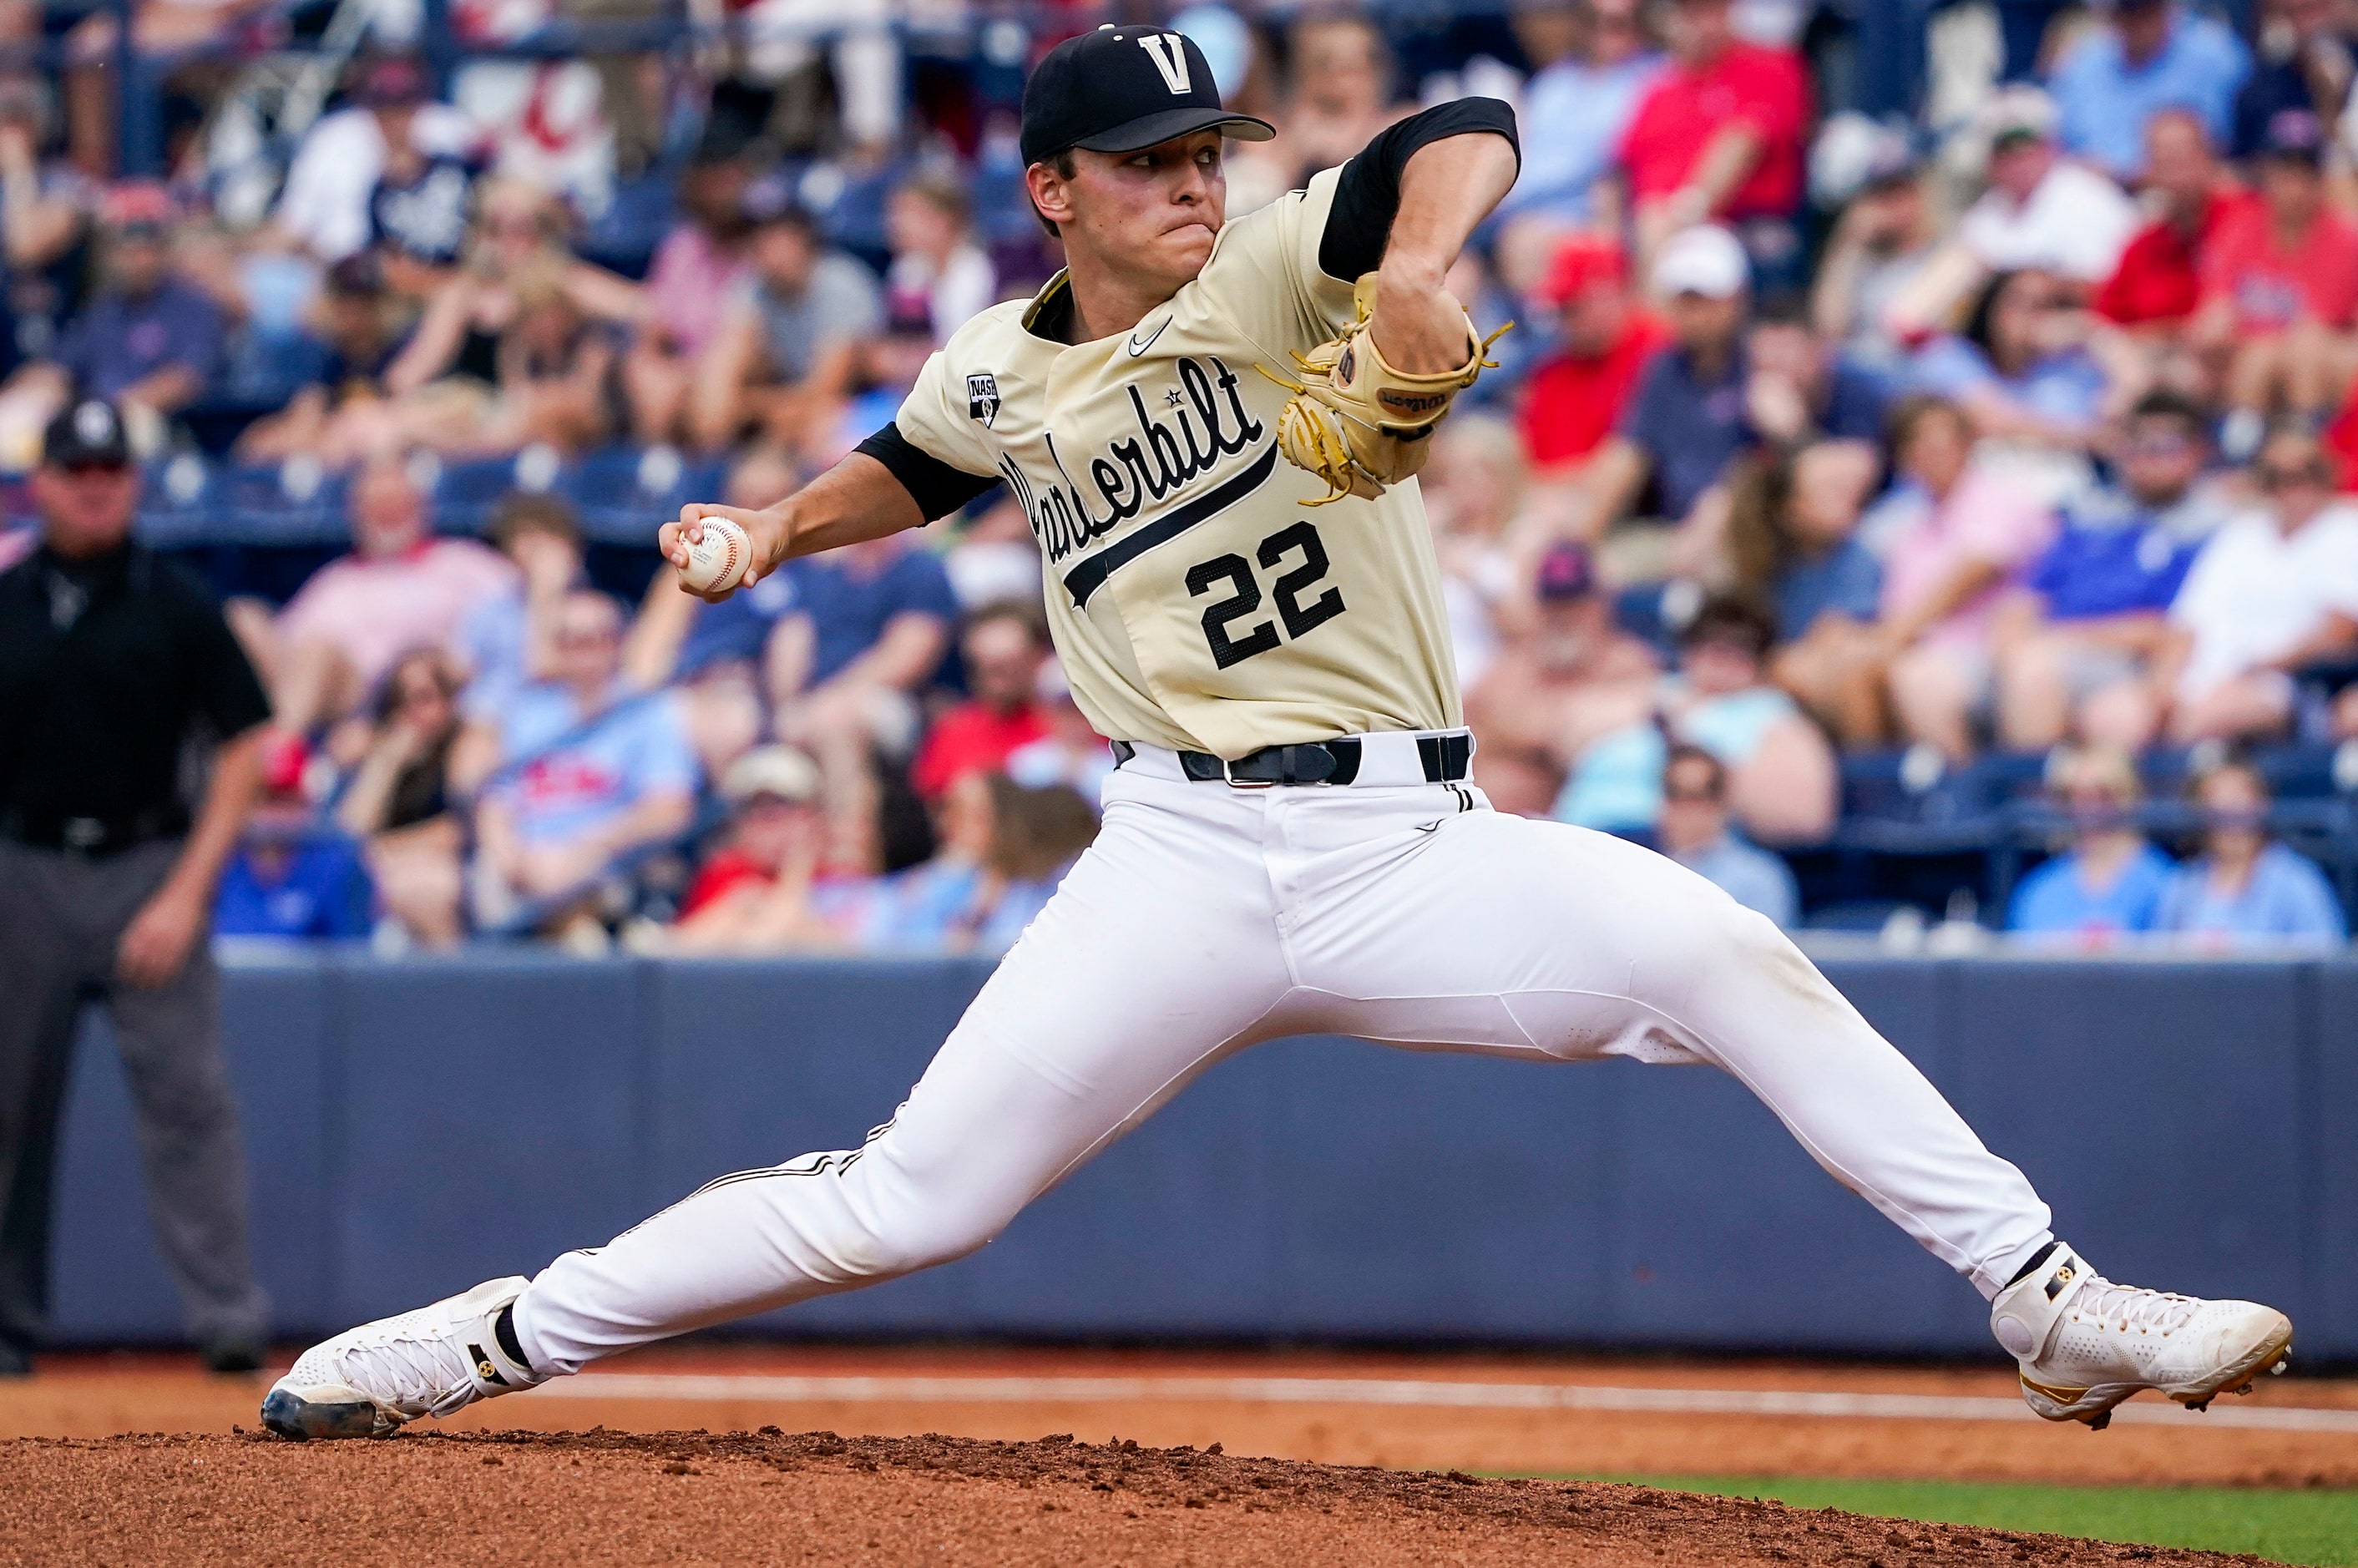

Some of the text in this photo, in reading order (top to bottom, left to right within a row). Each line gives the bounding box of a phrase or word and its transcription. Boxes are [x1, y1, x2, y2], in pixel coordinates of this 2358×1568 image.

[1136, 33, 1192, 95] V
[998, 357, 1263, 566] Vanderbilt
[1184, 520, 1347, 670] 22
